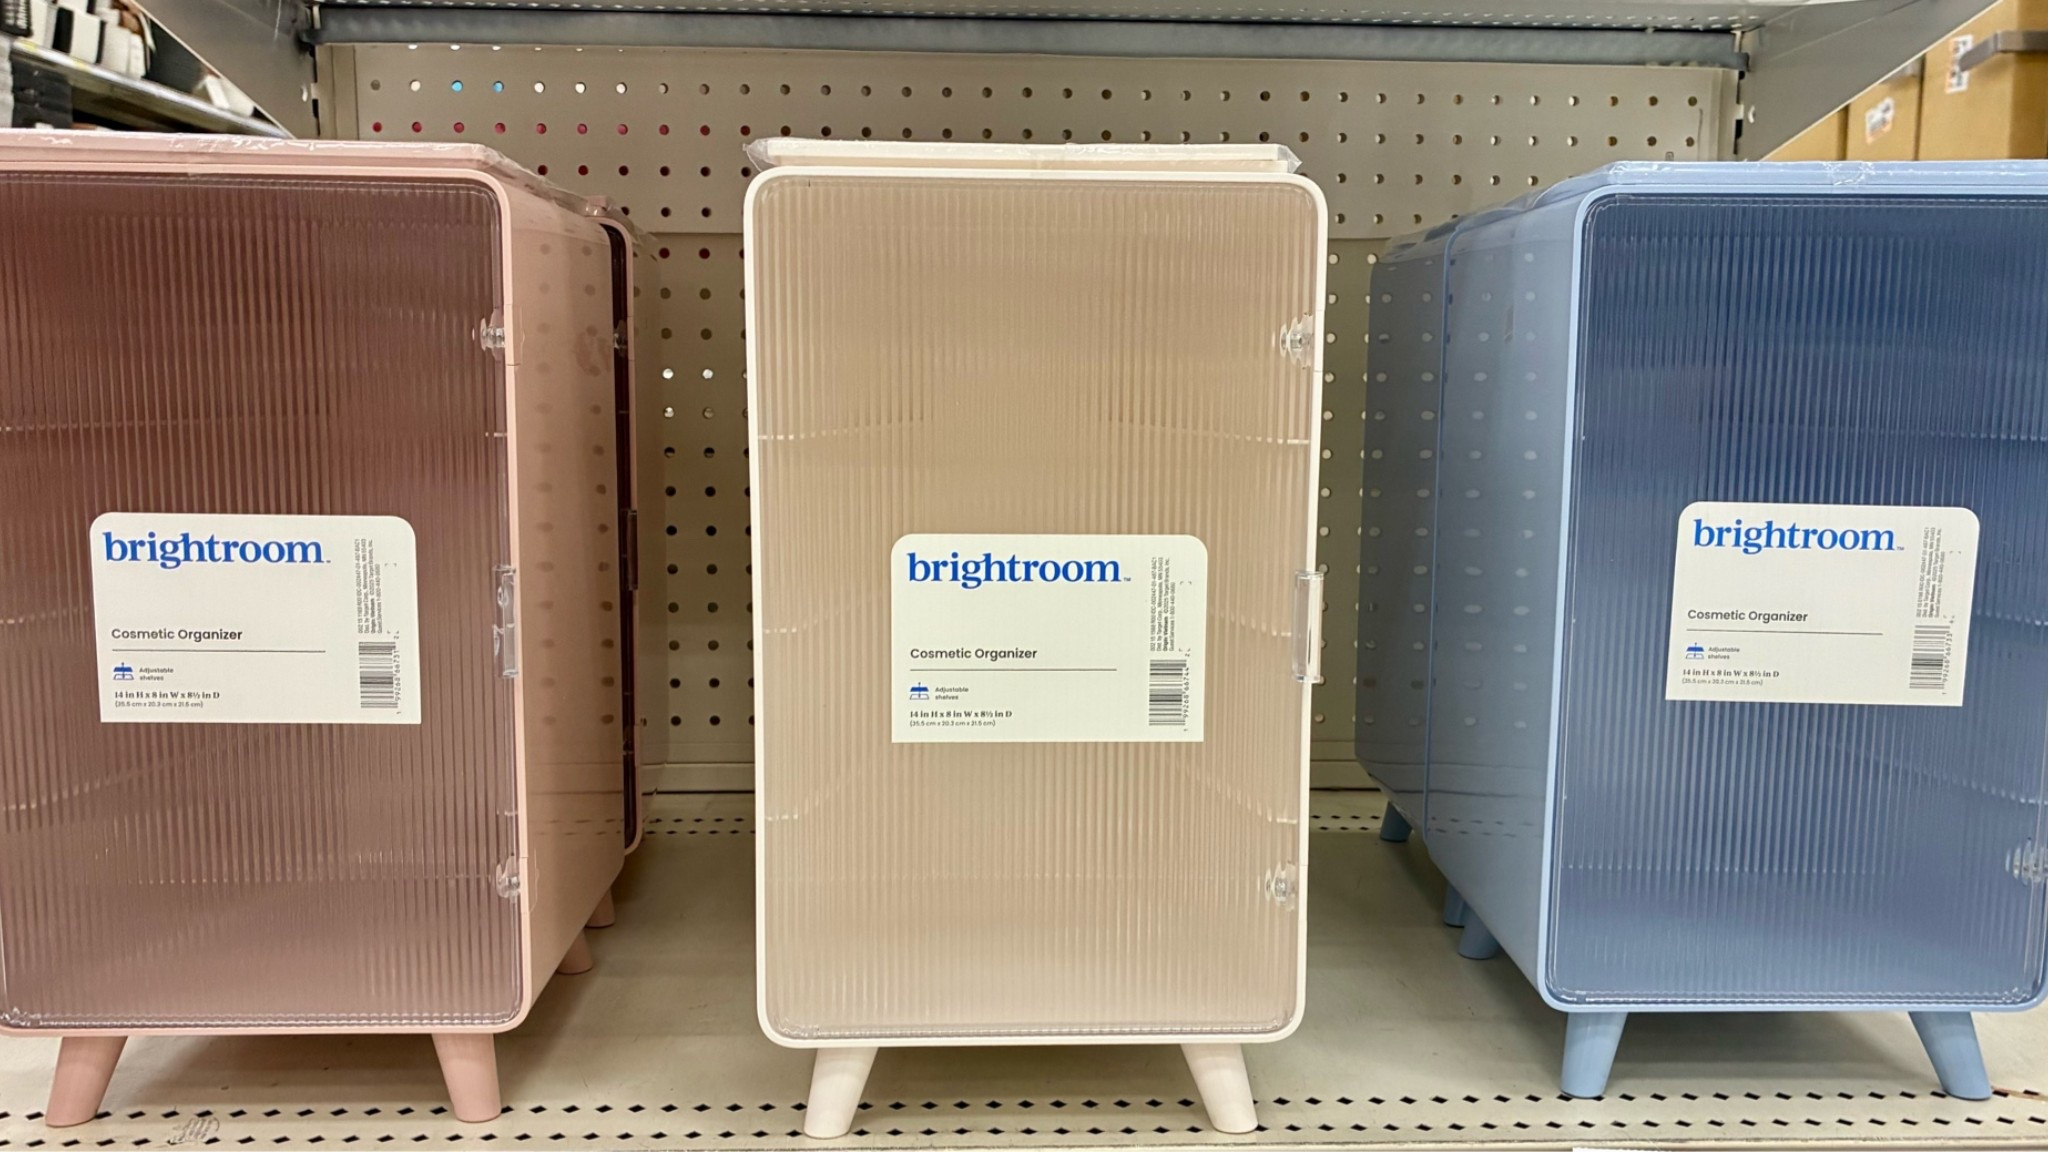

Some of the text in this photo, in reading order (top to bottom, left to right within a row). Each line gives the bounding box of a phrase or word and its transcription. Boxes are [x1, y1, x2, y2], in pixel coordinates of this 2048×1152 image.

[1687, 609, 1808, 623] Cosmetic Organizer
[111, 628, 243, 642] Cosmetic Organizer
[910, 648, 1037, 662] Cosmetic Organizer
[1717, 669, 1722, 677] 8
[1763, 670, 1771, 678] in
[136, 691, 143, 699] H
[152, 691, 157, 699] 8
[159, 691, 168, 699] in
[170, 691, 179, 699] W
[910, 710, 918, 718] 14
[920, 710, 929, 718] in
[931, 710, 938, 718] H
[946, 710, 951, 718] 8
[953, 710, 962, 718] in
[964, 710, 972, 718] W
[995, 710, 1003, 718] in
[1005, 710, 1012, 718] D
